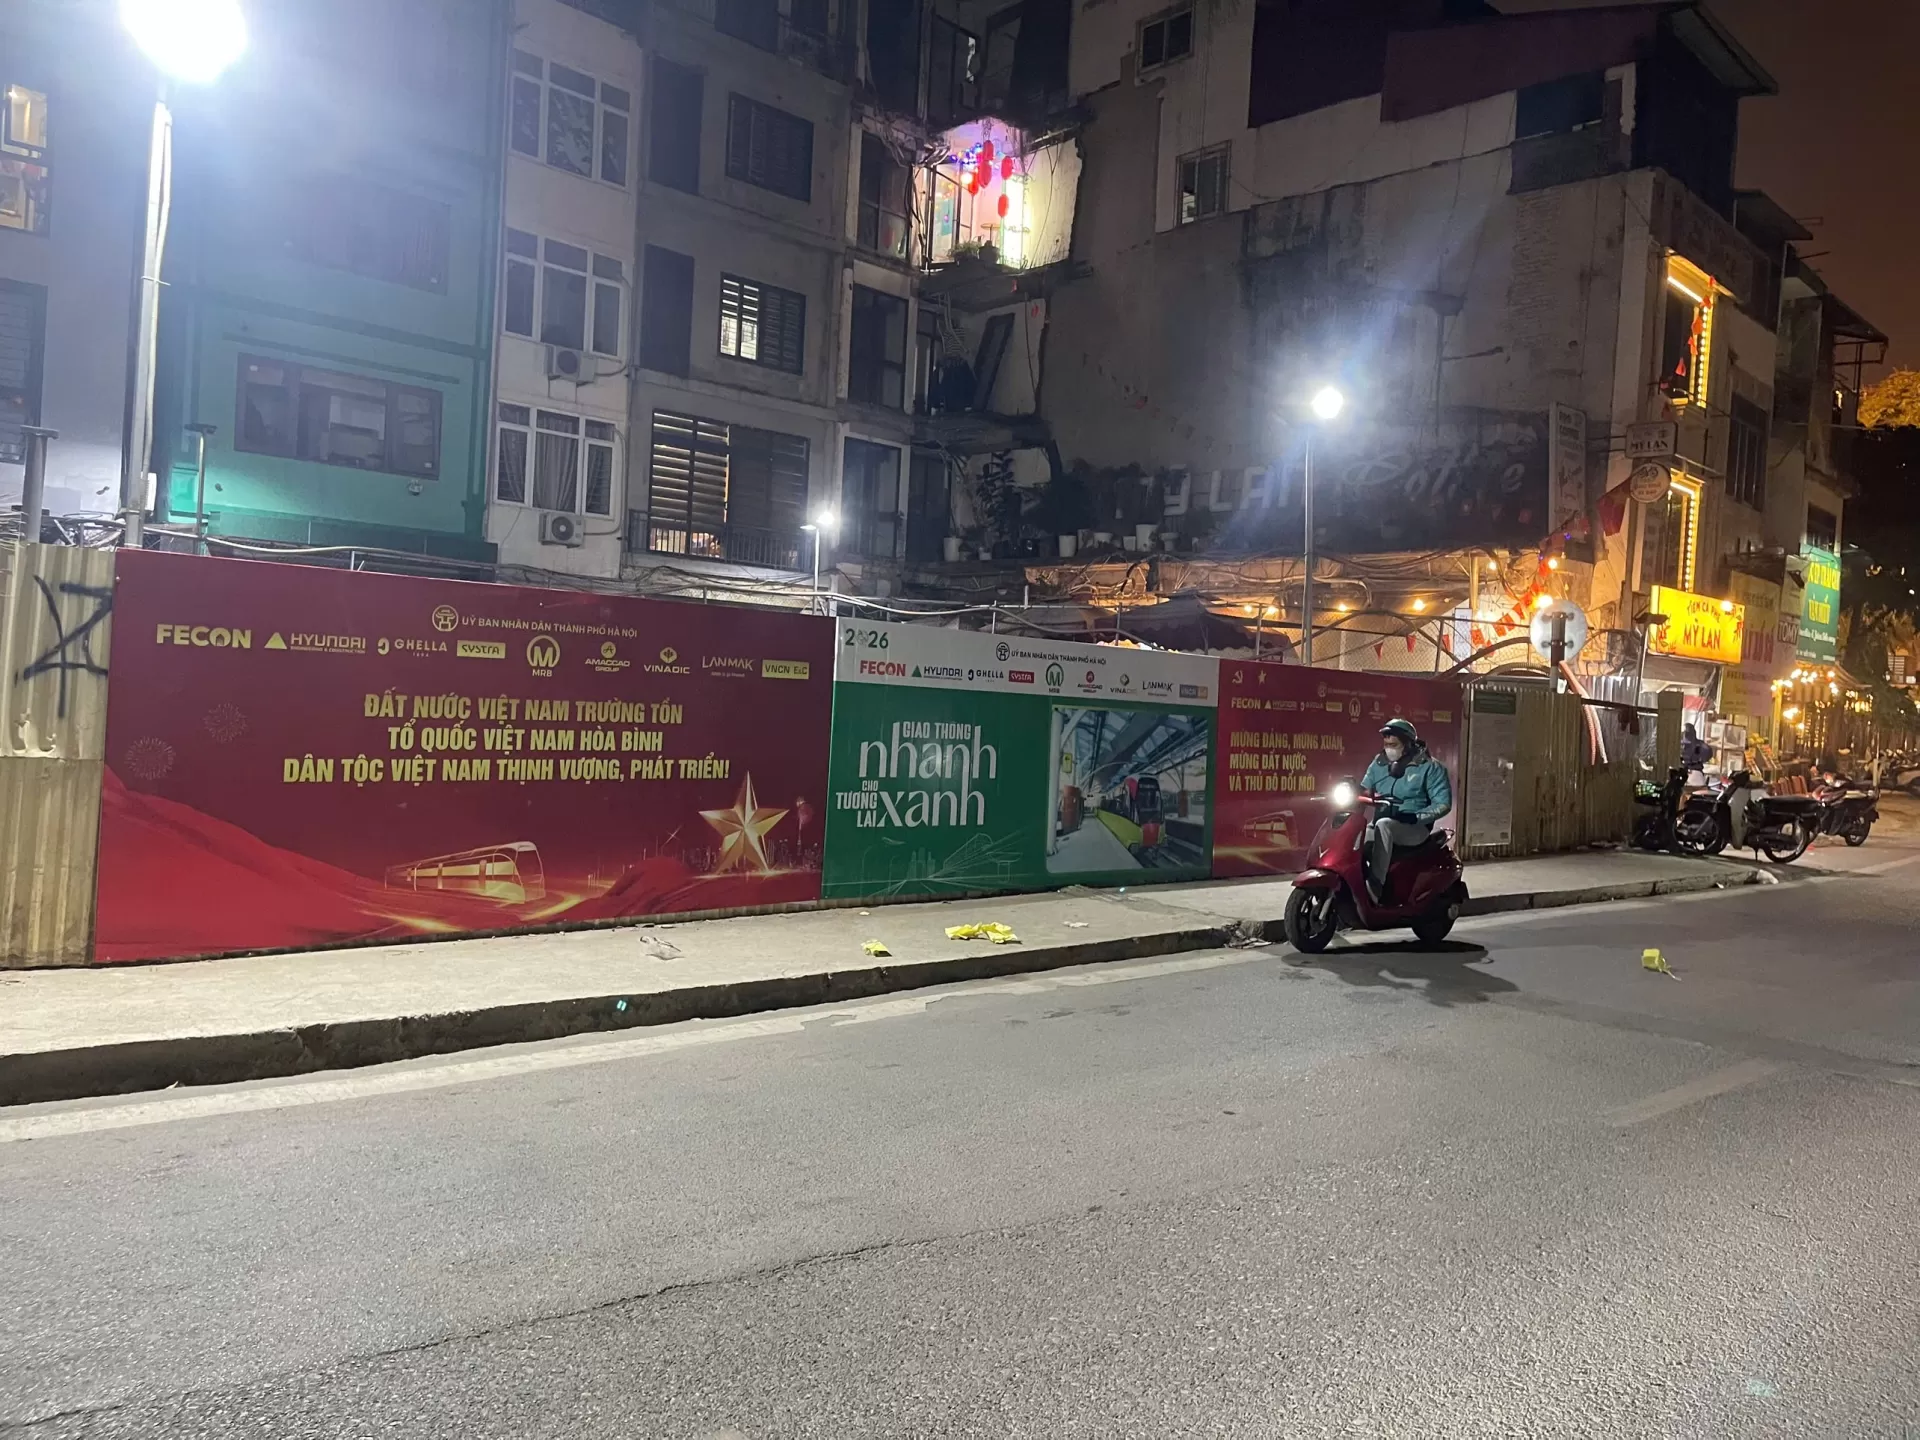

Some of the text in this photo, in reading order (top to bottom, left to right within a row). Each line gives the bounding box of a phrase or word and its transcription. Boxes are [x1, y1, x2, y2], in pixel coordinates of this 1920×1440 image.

[156, 624, 252, 648] FECON
[478, 618, 500, 628] BAN
[501, 619, 530, 630] NHÂN
[531, 621, 552, 632] DÂN
[554, 622, 585, 634] THÀNH
[586, 624, 606, 636] PHỐ
[607, 626, 621, 637] HÀ
[622, 628, 638, 640] NỘI
[291, 632, 366, 649] HYUNDAI
[394, 638, 448, 652] GHELLA
[1702, 626, 1721, 651] LAN
[461, 644, 500, 655] SYSTRA
[585, 658, 631, 668] AMACCAO
[644, 664, 691, 675] VINADIC
[702, 656, 755, 672] LANMAK
[765, 664, 790, 674] VNCN
[860, 660, 906, 677] FECON
[532, 669, 553, 678] MRB
[923, 666, 963, 678] HYUNDAI
[976, 669, 1005, 679] GHELLA
[1142, 681, 1173, 692] LANMAK
[364, 686, 683, 725] ĐẤT NƯỚC VIỆT NAM TRƯỜNG TỒN
[1231, 696, 1261, 710] FECON
[388, 718, 663, 755] TỔ QUỐC VIỆT NAM HÒA BÌNH
[902, 721, 930, 738] GIAO
[858, 722, 997, 779] nhanh
[1230, 750, 1260, 769] MỪNG
[283, 751, 730, 787] DÂN TỘC VIỆT NAM THỊNH VƯỢNG, PHÁT TRIỂN!
[862, 780, 879, 792] CHO
[1229, 772, 1242, 791] VÀ
[836, 790, 878, 809] TƯƠNG
[877, 784, 985, 828] xanh
[856, 810, 877, 828] LAI
